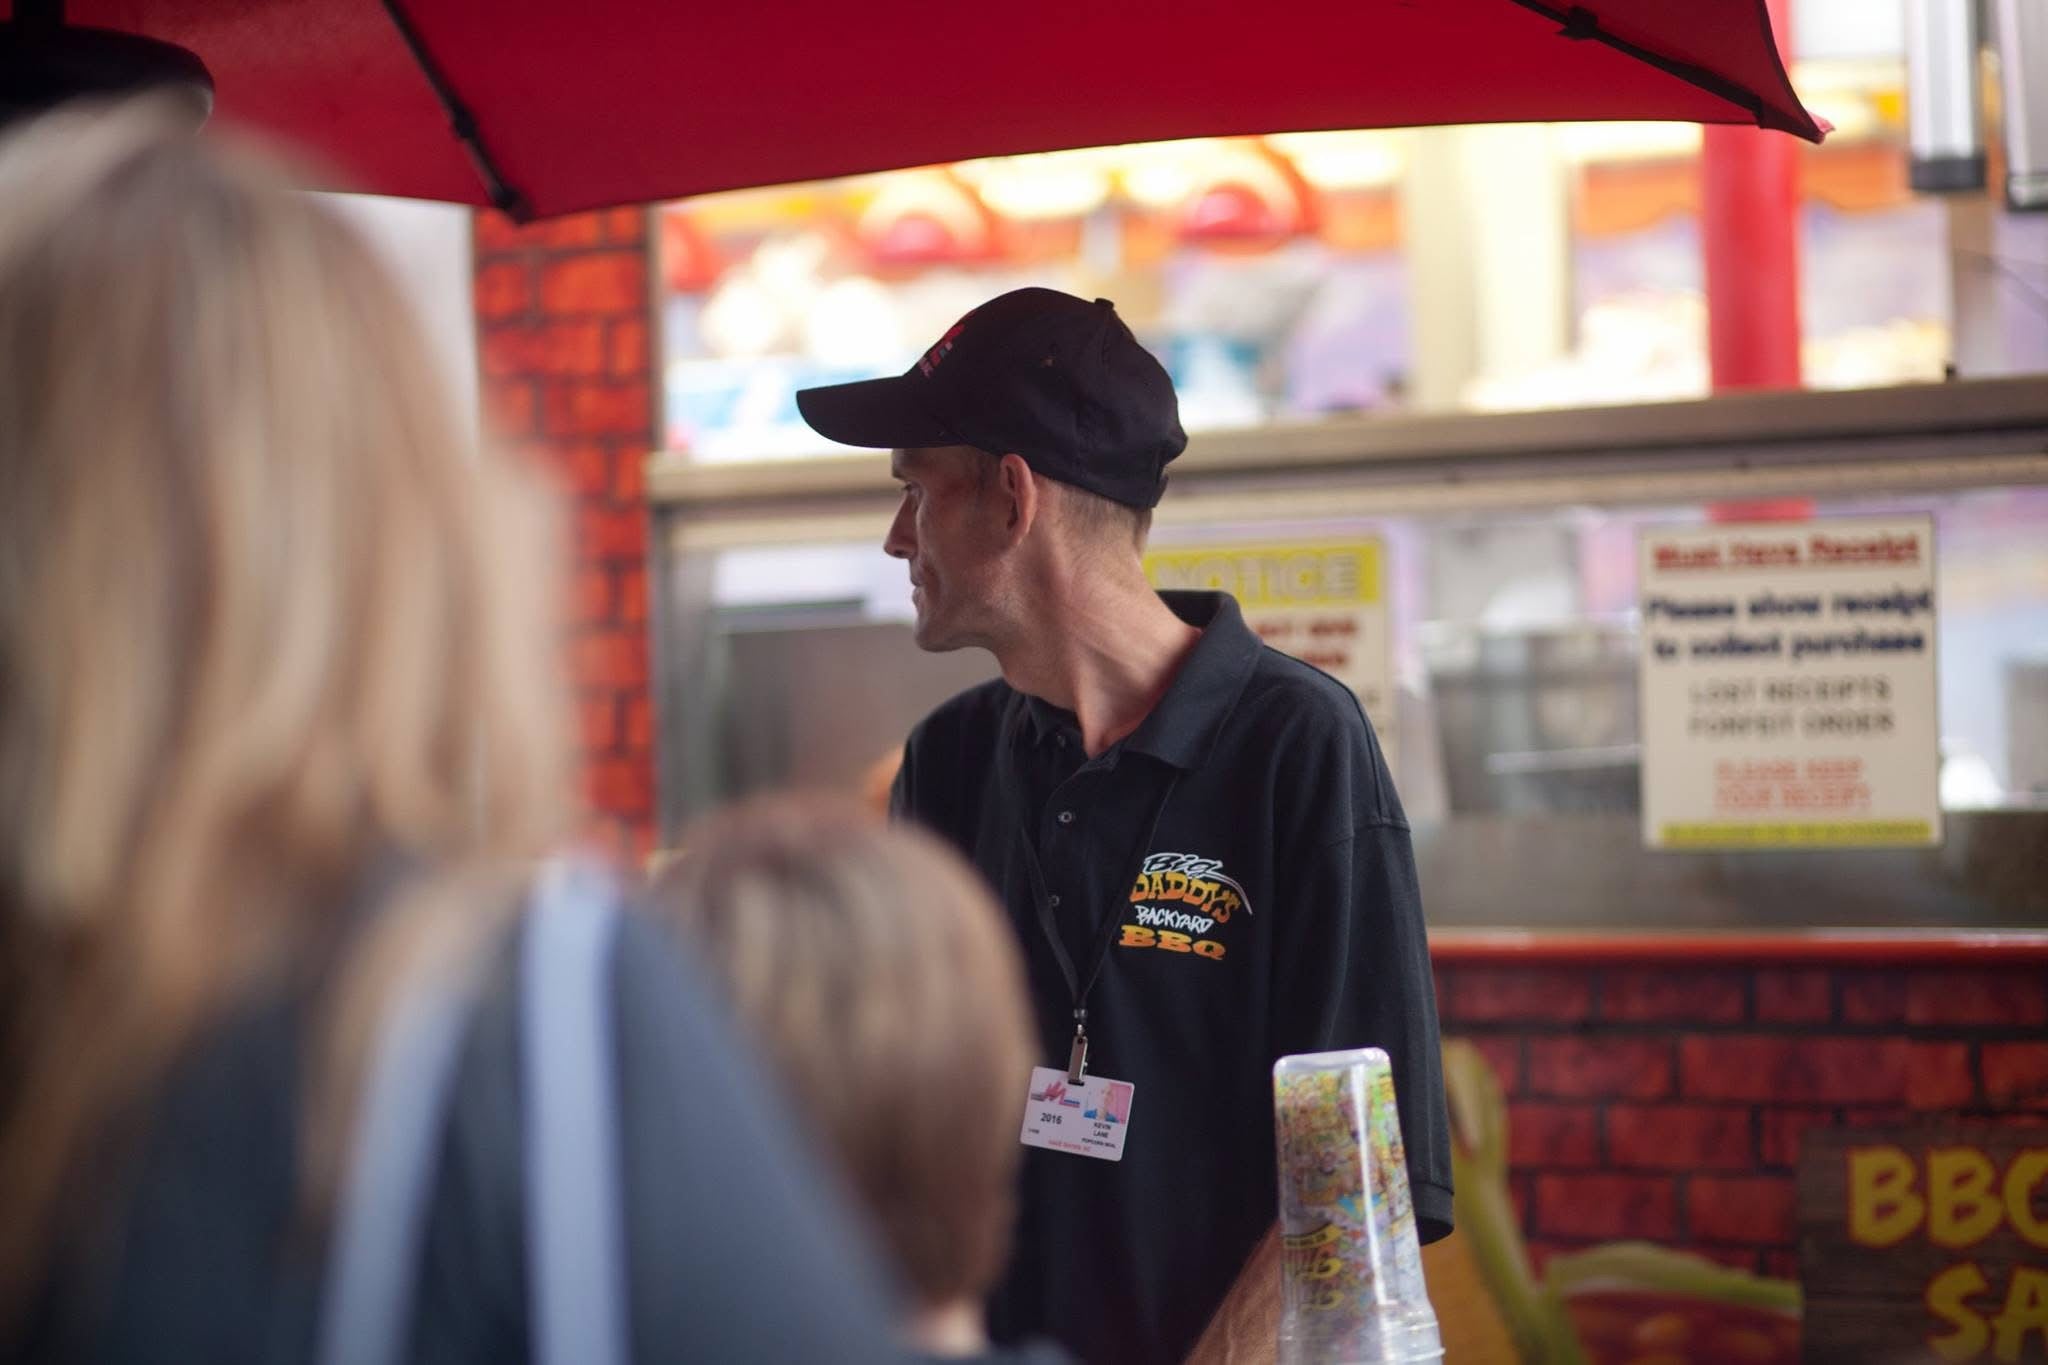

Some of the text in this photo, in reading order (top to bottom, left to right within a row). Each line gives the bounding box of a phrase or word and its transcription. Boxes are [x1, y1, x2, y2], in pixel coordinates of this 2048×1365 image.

[1129, 872, 1241, 923] DADDY'S
[1134, 905, 1215, 934] BACKYARD
[1119, 925, 1226, 961] BBQ
[1041, 1112, 1062, 1125] 2016
